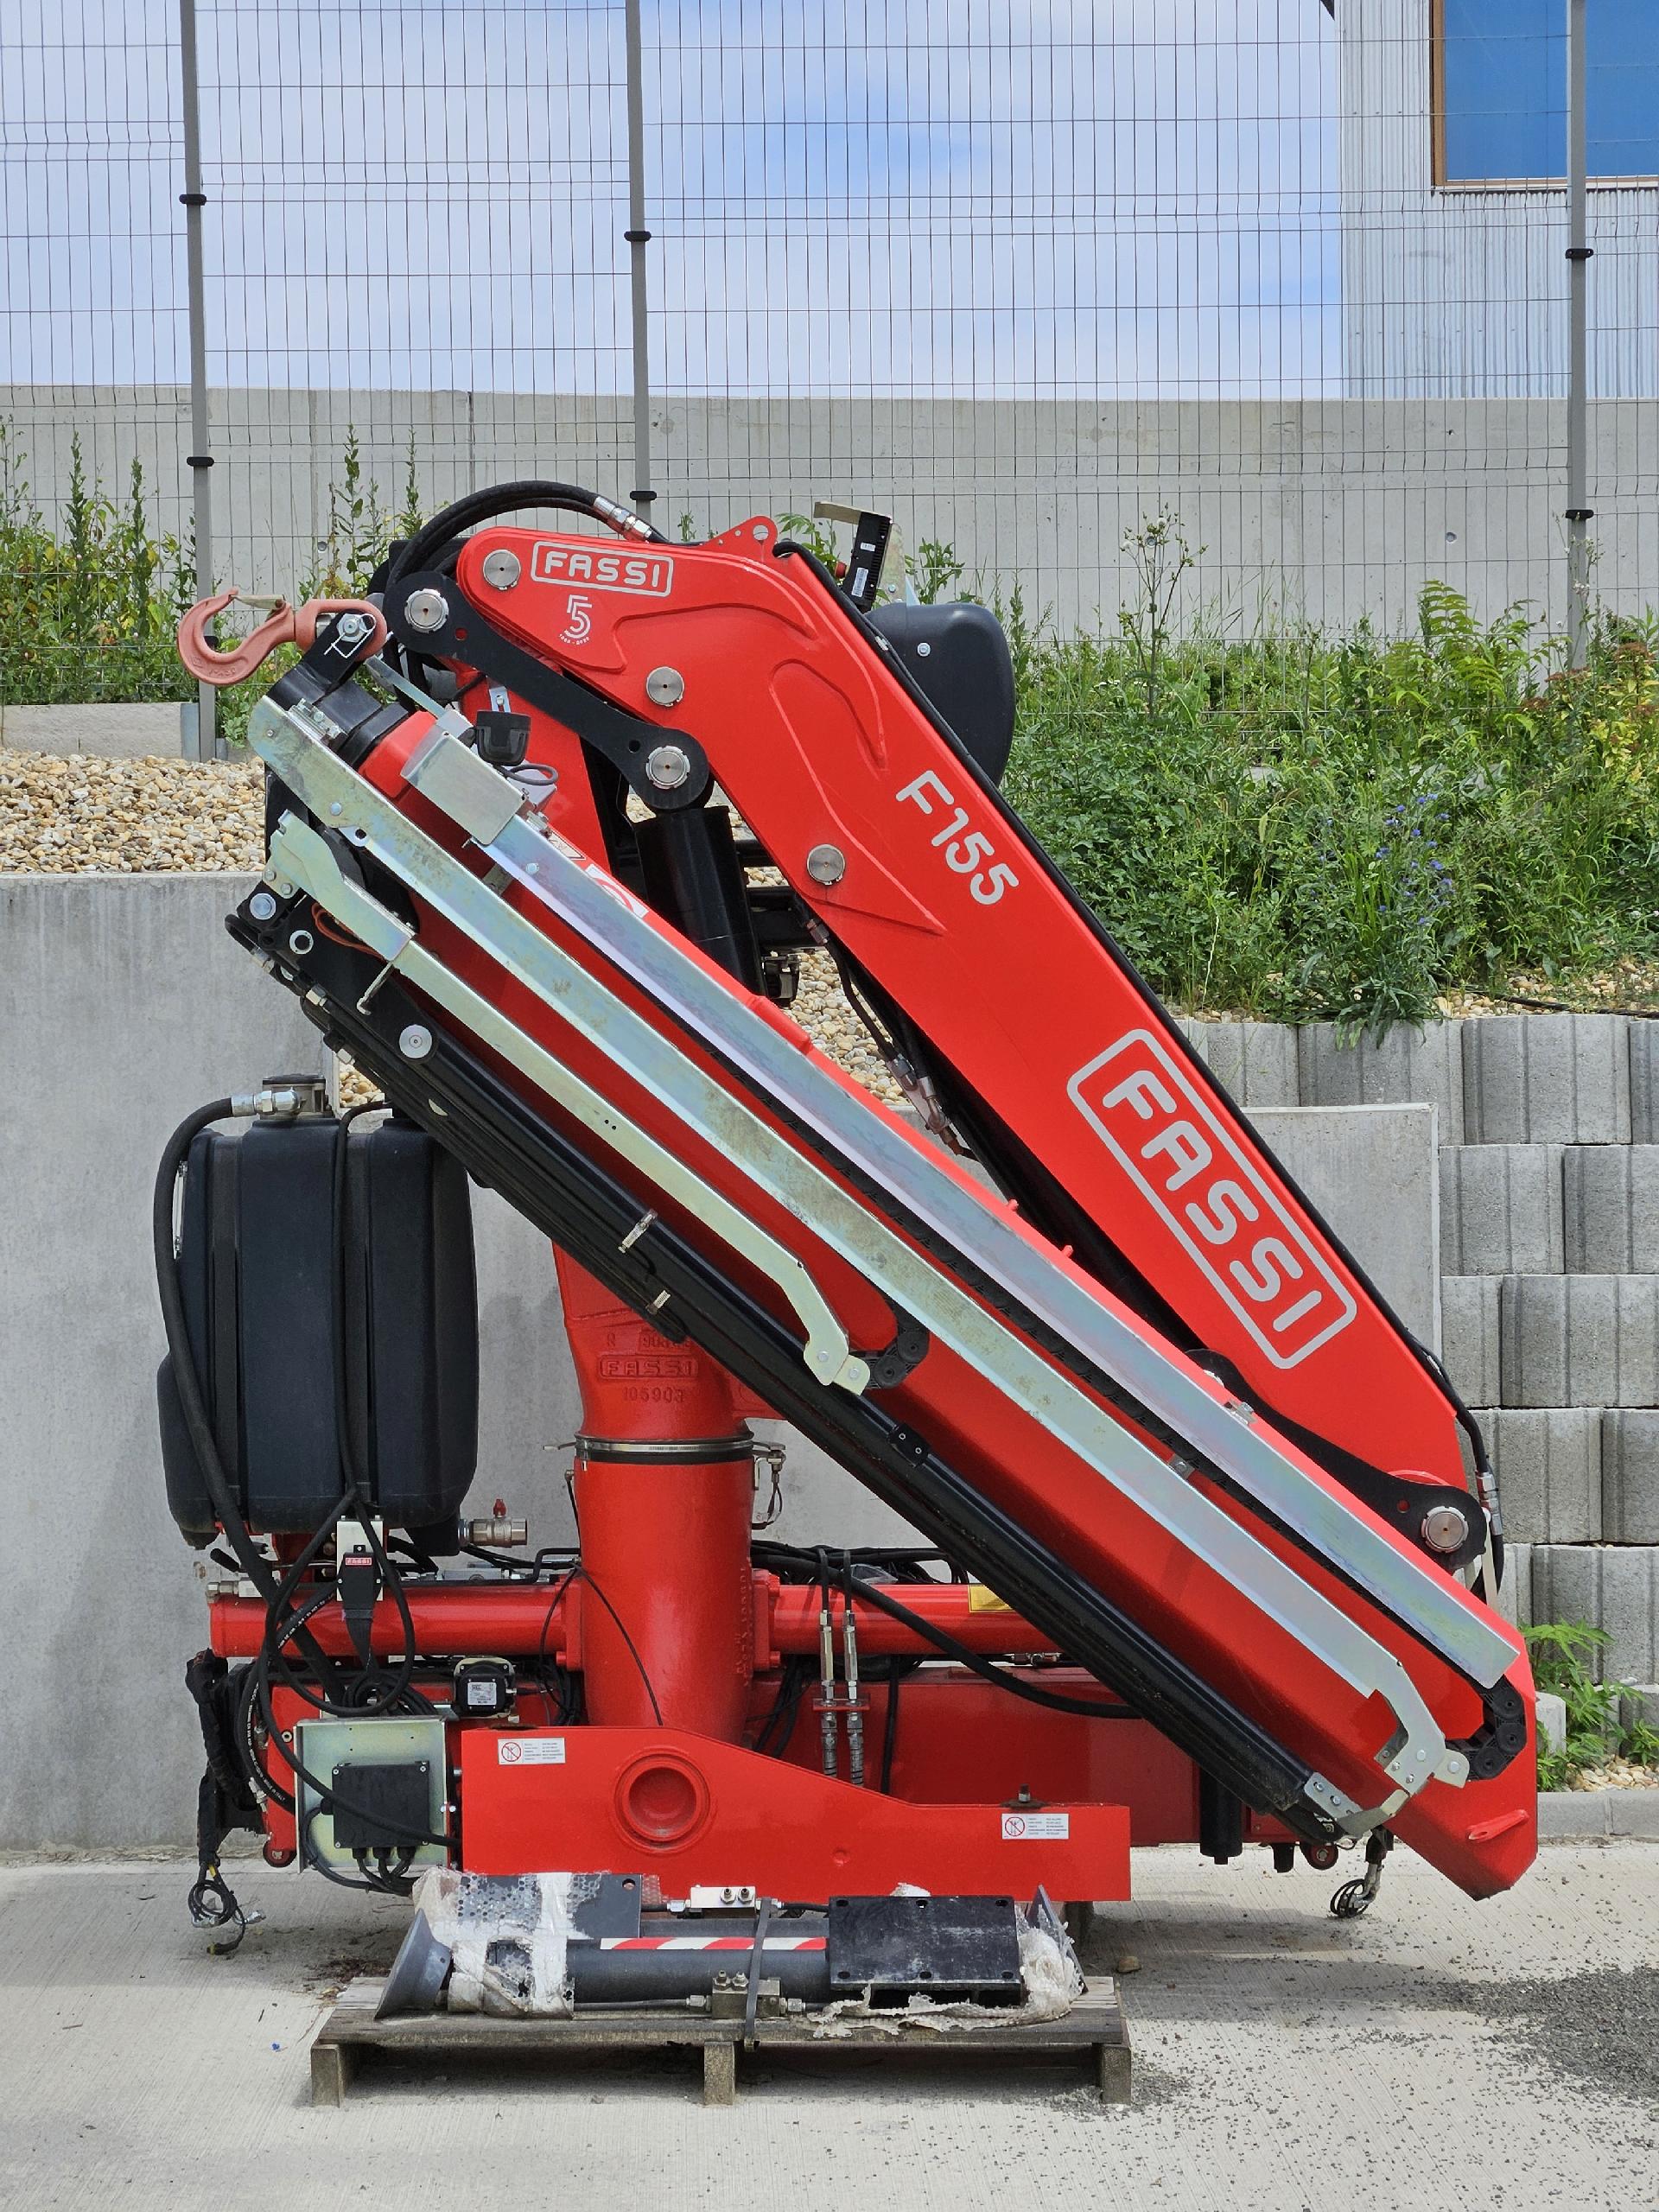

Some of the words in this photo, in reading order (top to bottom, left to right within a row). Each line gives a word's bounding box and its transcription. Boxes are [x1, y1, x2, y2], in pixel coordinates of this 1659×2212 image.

[544, 550, 660, 588] FASSI
[895, 770, 1020, 905] F155
[1103, 1070, 1323, 1332] FASSI
[607, 1360, 692, 1376] FASSI
